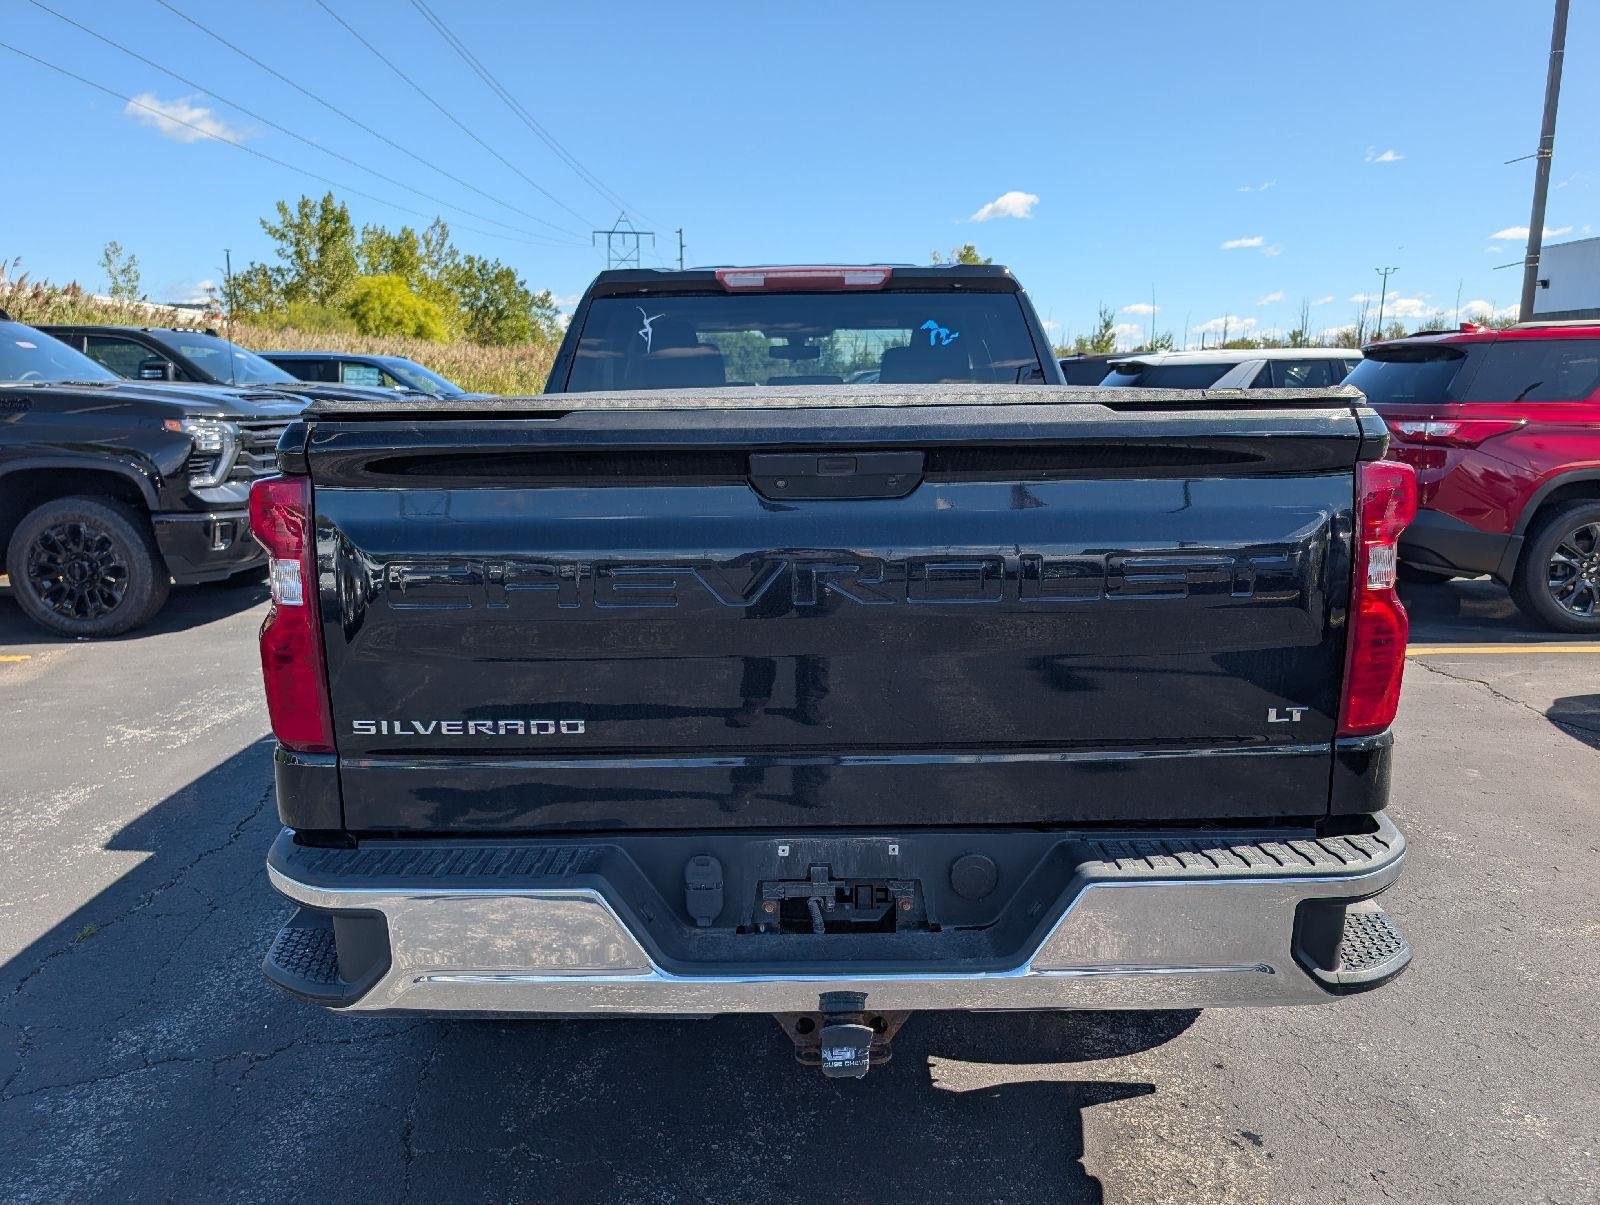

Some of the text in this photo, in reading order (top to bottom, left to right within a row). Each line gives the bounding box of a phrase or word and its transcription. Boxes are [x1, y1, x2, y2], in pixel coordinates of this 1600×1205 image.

[383, 552, 1289, 609] CHEVROLET
[1267, 706, 1309, 723] LT
[353, 719, 586, 736] SILVERADO
